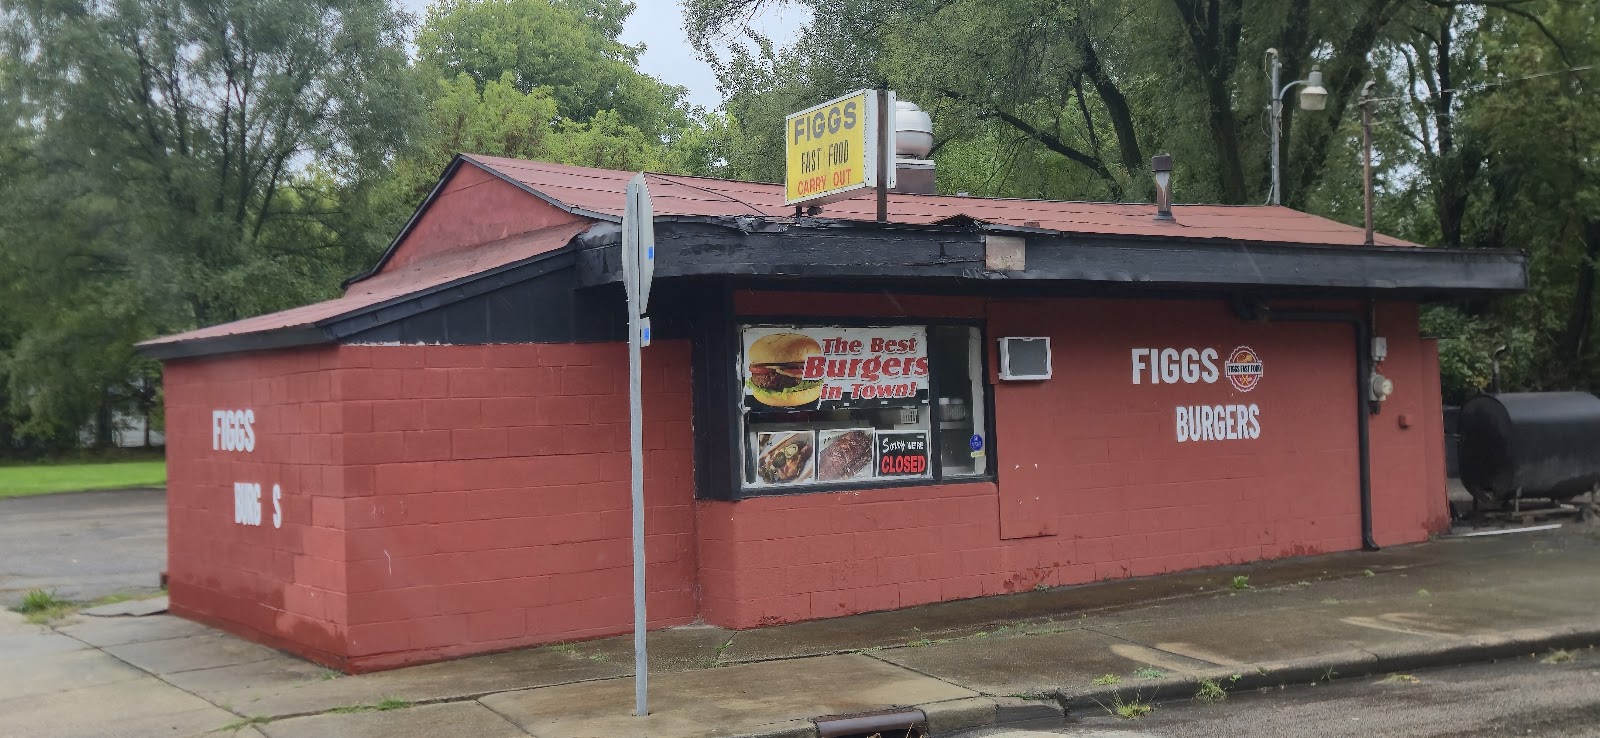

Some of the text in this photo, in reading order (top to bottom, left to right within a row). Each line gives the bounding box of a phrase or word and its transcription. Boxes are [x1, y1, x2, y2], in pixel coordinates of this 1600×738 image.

[794, 101, 857, 145] FIGGS
[801, 139, 849, 174] FAST FOOD
[797, 168, 851, 196] CARRY OUT
[822, 336, 918, 355] The Best
[803, 354, 929, 382] Burgers
[1131, 347, 1219, 385] FIGGS
[1228, 364, 1262, 373] FIGGS FAST FOOD
[820, 381, 918, 400] in Town!
[212, 408, 256, 453] FIGGS
[1175, 403, 1261, 443] BURGERS
[882, 437, 906, 454] Sorry
[881, 454, 926, 474] CLOSED
